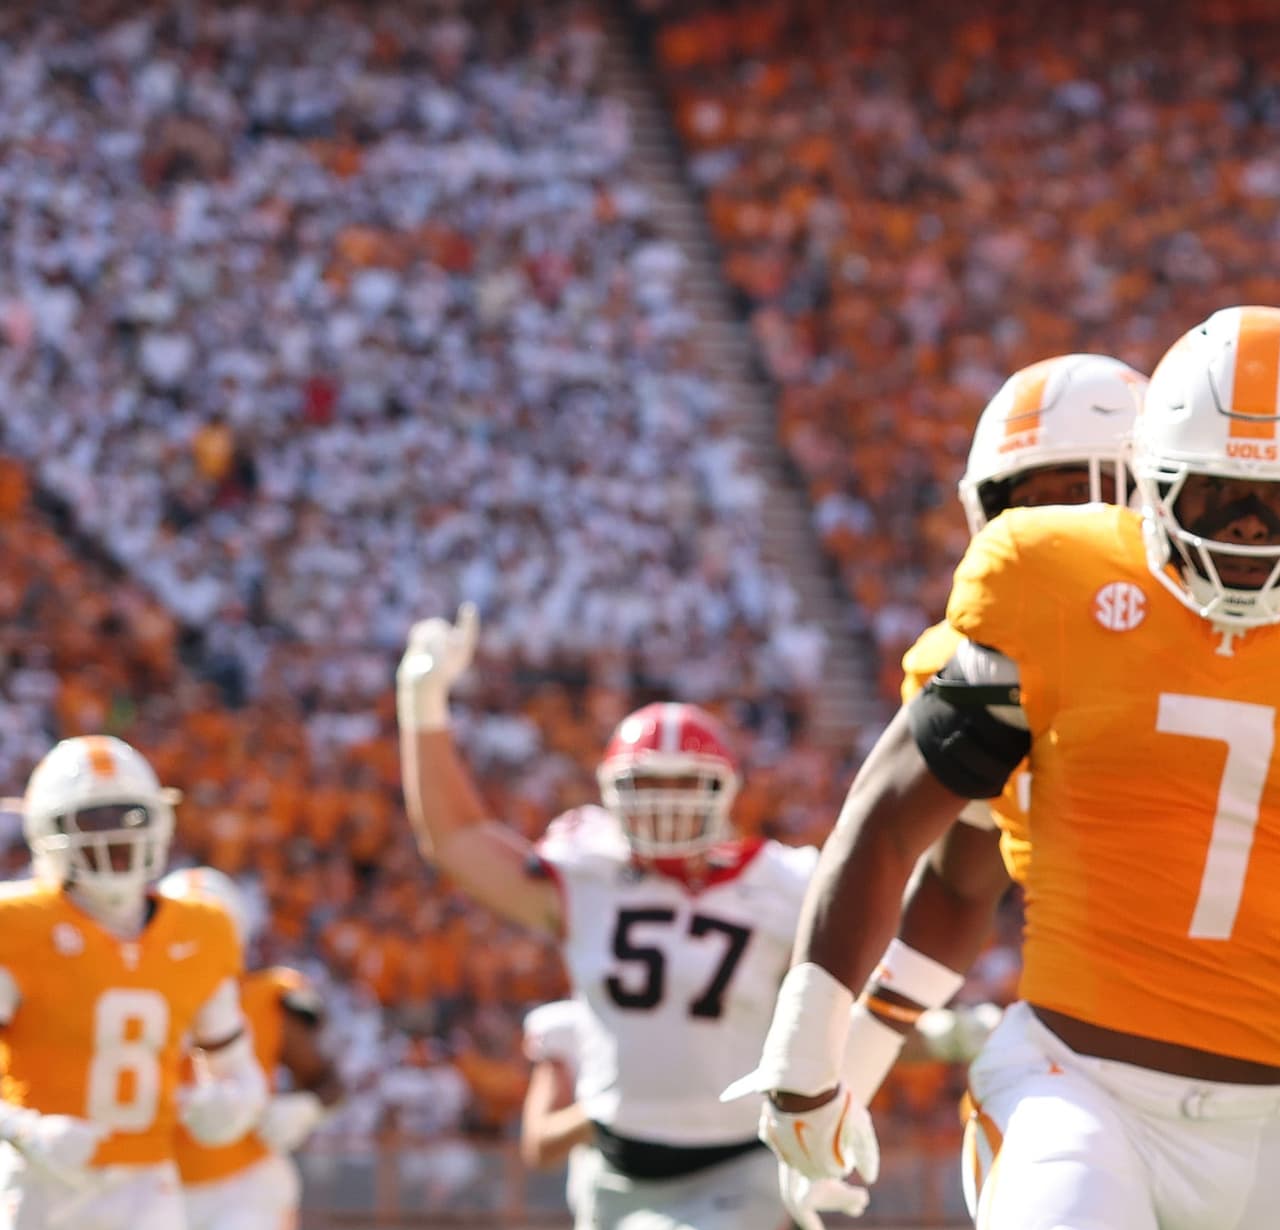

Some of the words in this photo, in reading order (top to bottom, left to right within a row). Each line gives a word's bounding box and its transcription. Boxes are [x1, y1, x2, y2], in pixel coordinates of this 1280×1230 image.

[1225, 442, 1278, 463] VOLS
[1094, 581, 1147, 632] SEC
[1155, 691, 1277, 942] 7
[605, 906, 755, 1020] 57
[86, 984, 171, 1134] 8
